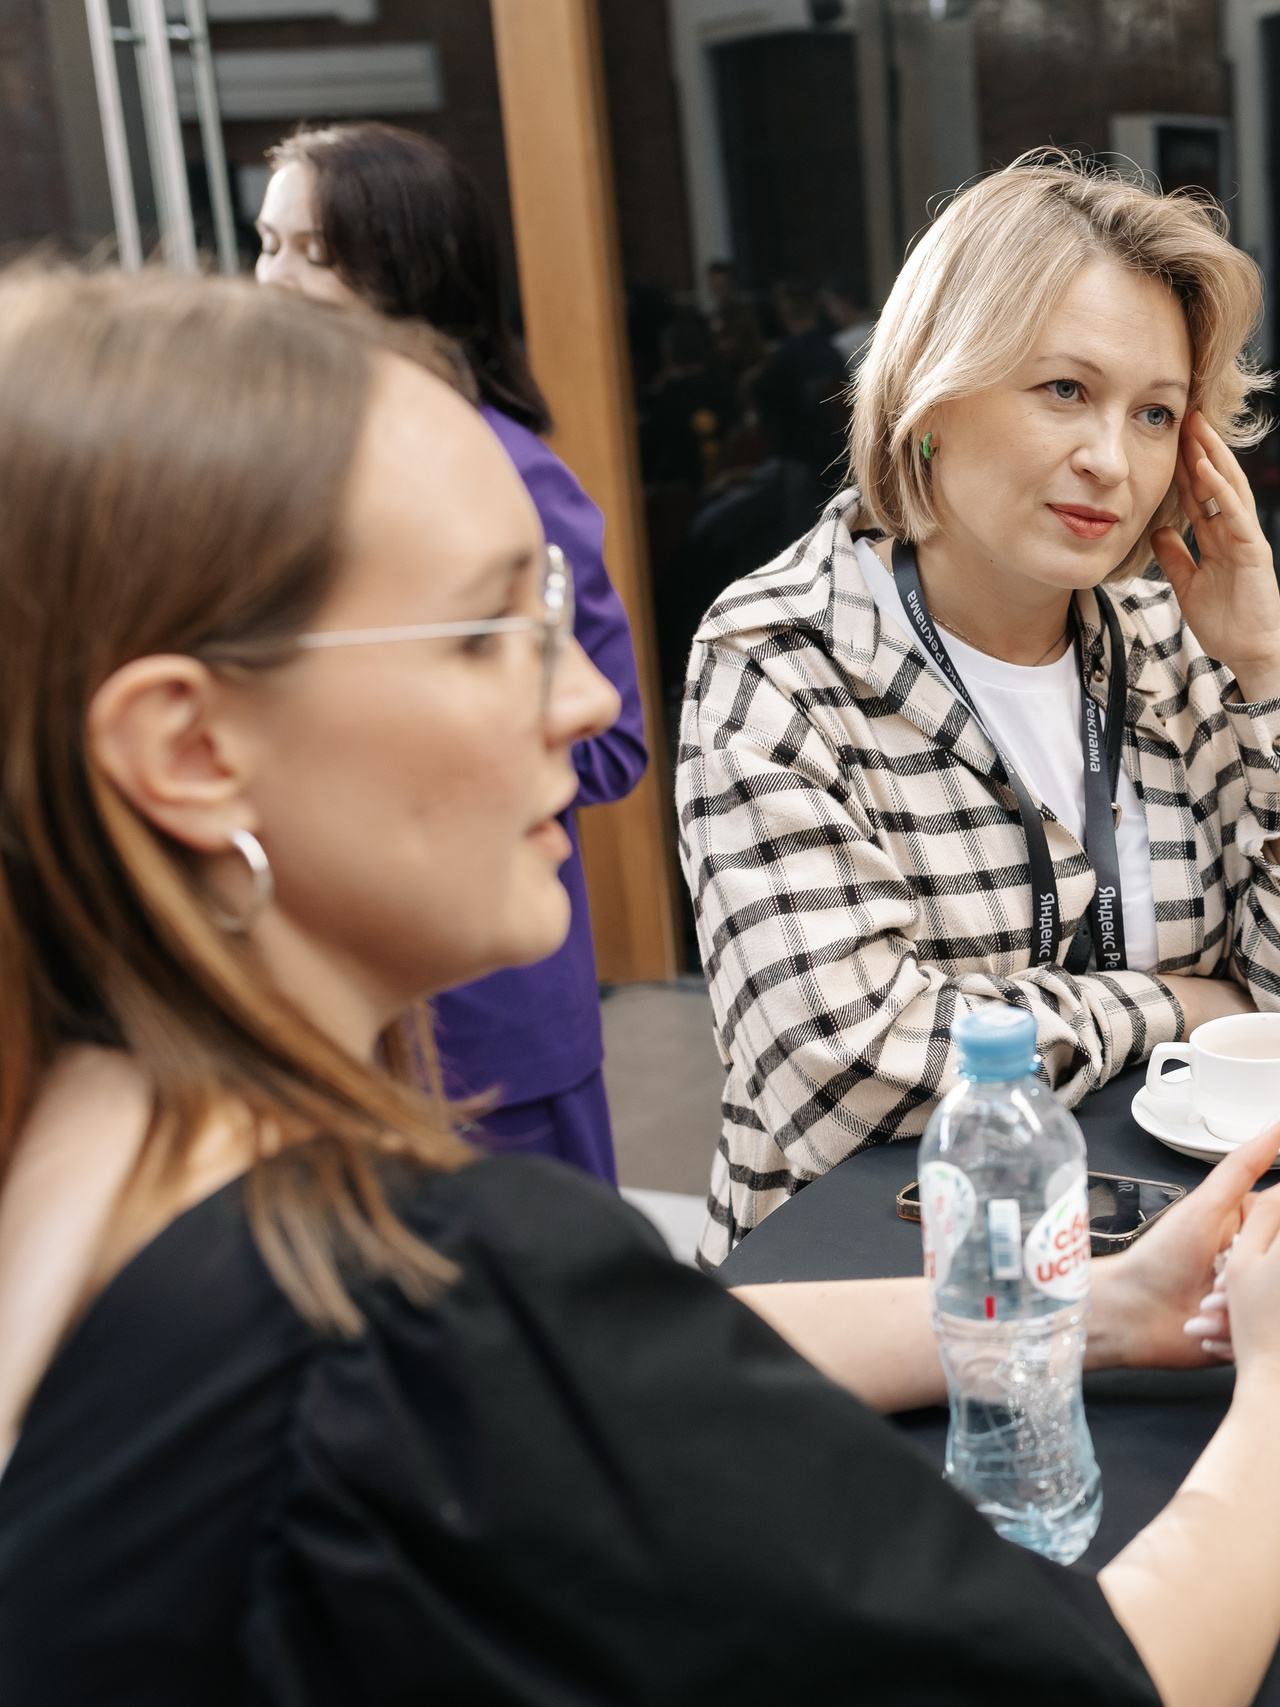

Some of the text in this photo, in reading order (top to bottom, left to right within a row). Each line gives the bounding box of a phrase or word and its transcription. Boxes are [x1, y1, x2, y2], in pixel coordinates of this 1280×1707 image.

[906, 589, 945, 665] Реклама
[1086, 697, 1101, 773] Реклама
[1039, 892, 1055, 958] Яндекс
[1098, 886, 1116, 949] Яндекс
